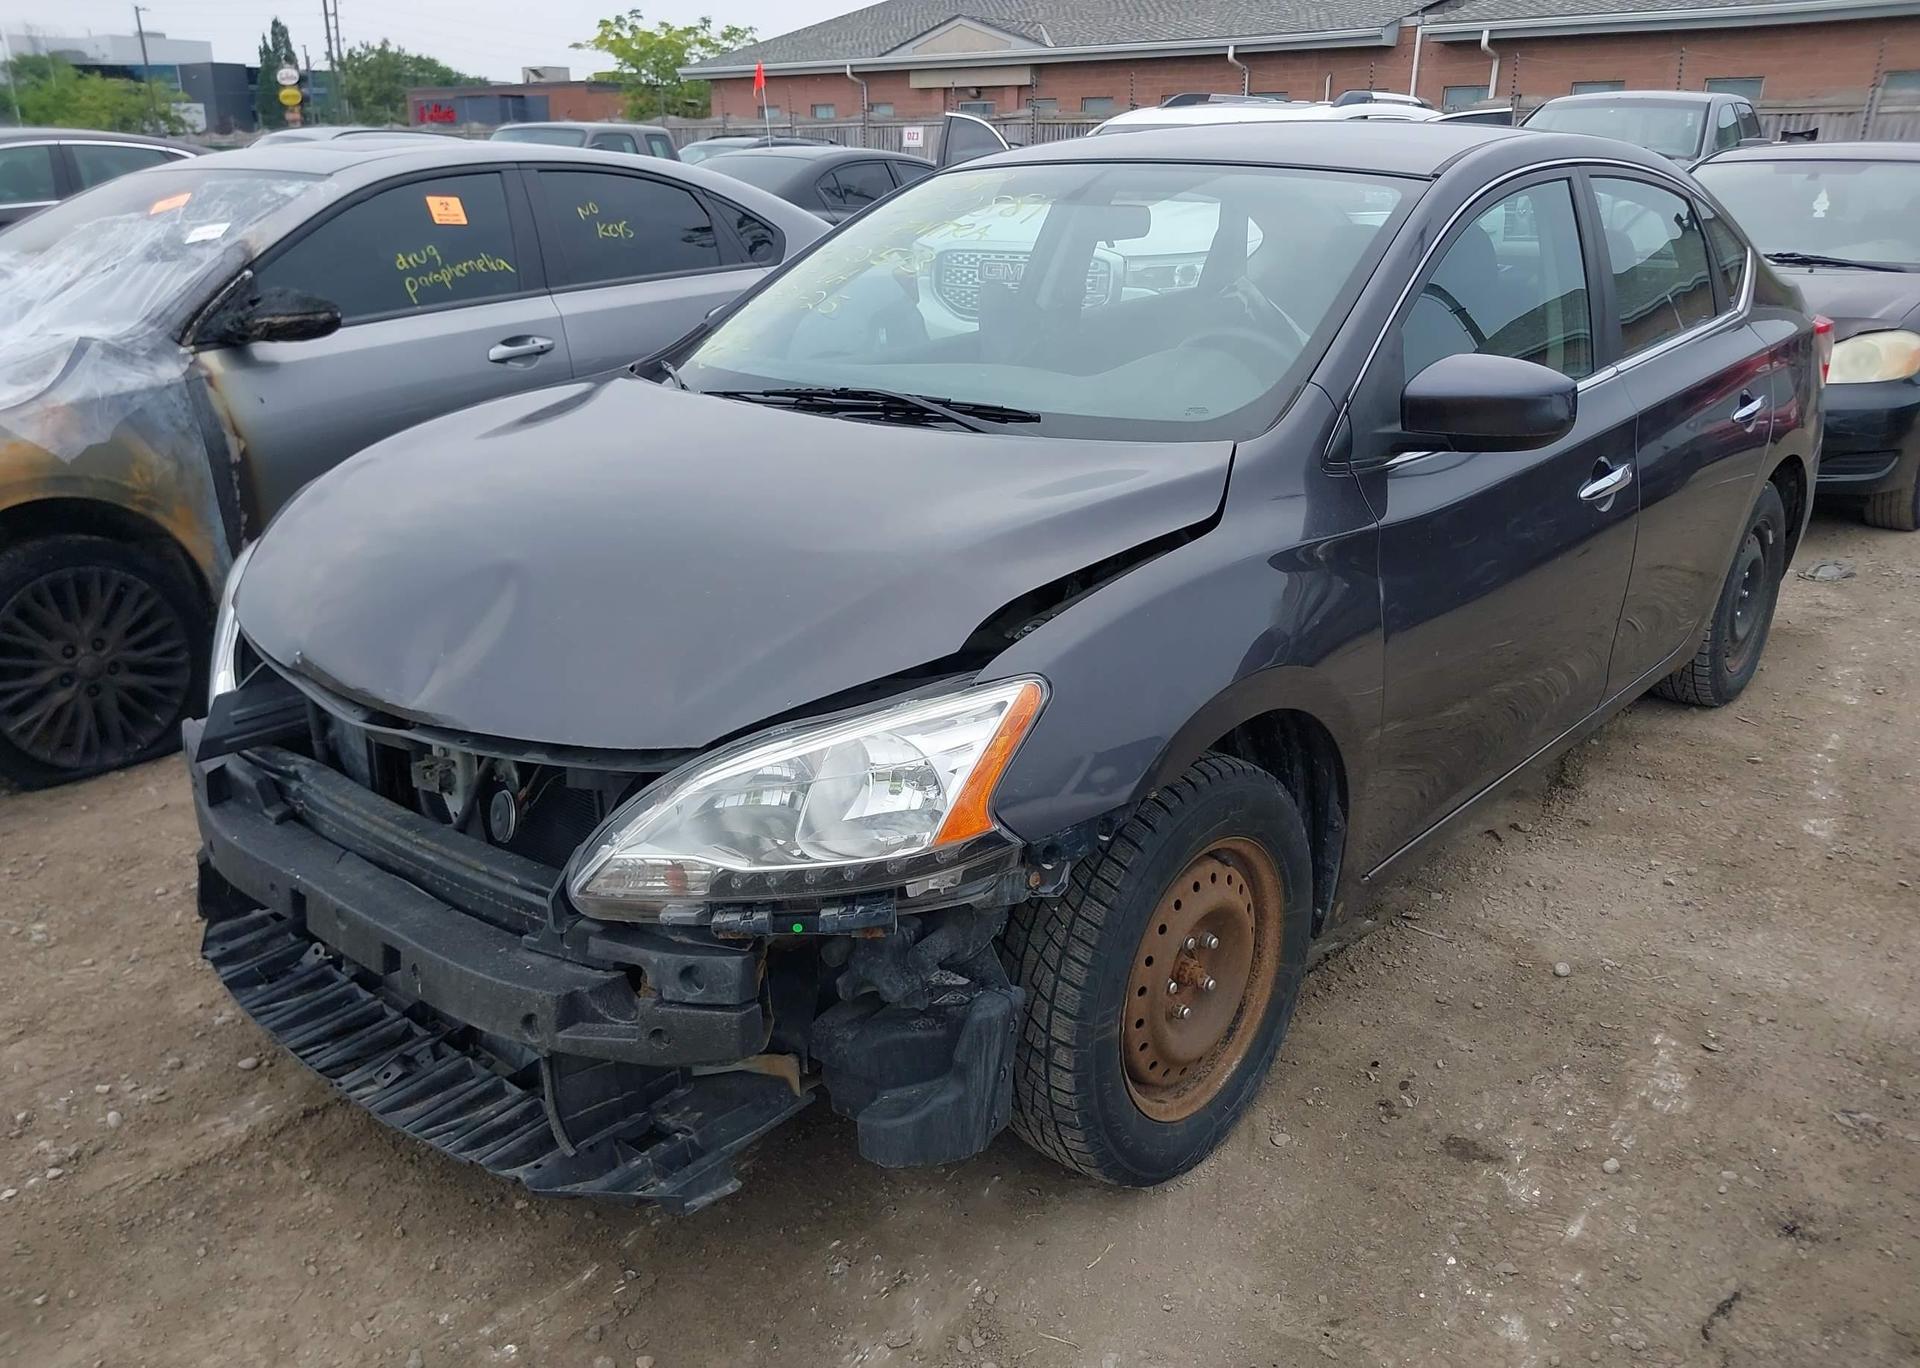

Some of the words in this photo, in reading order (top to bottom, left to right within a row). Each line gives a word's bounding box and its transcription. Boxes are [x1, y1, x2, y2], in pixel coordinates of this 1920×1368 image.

[577, 202, 599, 220] NO
[396, 245, 442, 271] drug
[982, 262, 1025, 281] GM
